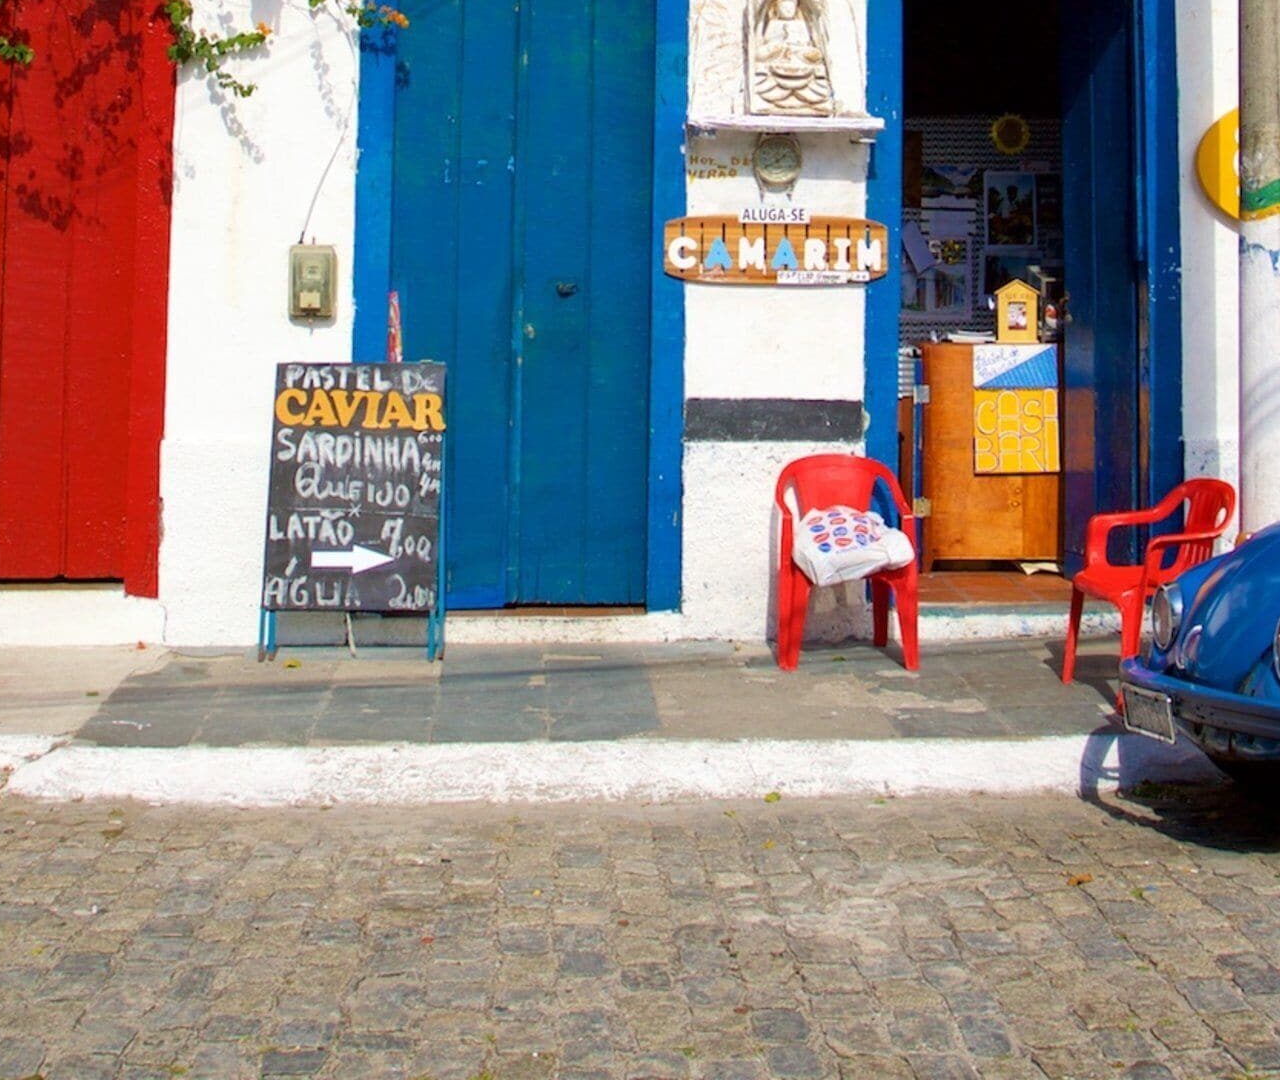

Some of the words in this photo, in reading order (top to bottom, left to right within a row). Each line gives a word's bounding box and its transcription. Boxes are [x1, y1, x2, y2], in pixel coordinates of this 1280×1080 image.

[742, 208, 805, 221] ALUGA-SE
[668, 237, 882, 271] CAMARIM
[285, 365, 392, 390] PASTEL
[275, 388, 446, 431] CAVIAR
[270, 509, 355, 546] LATÃO
[263, 556, 361, 607] ÁGUA
